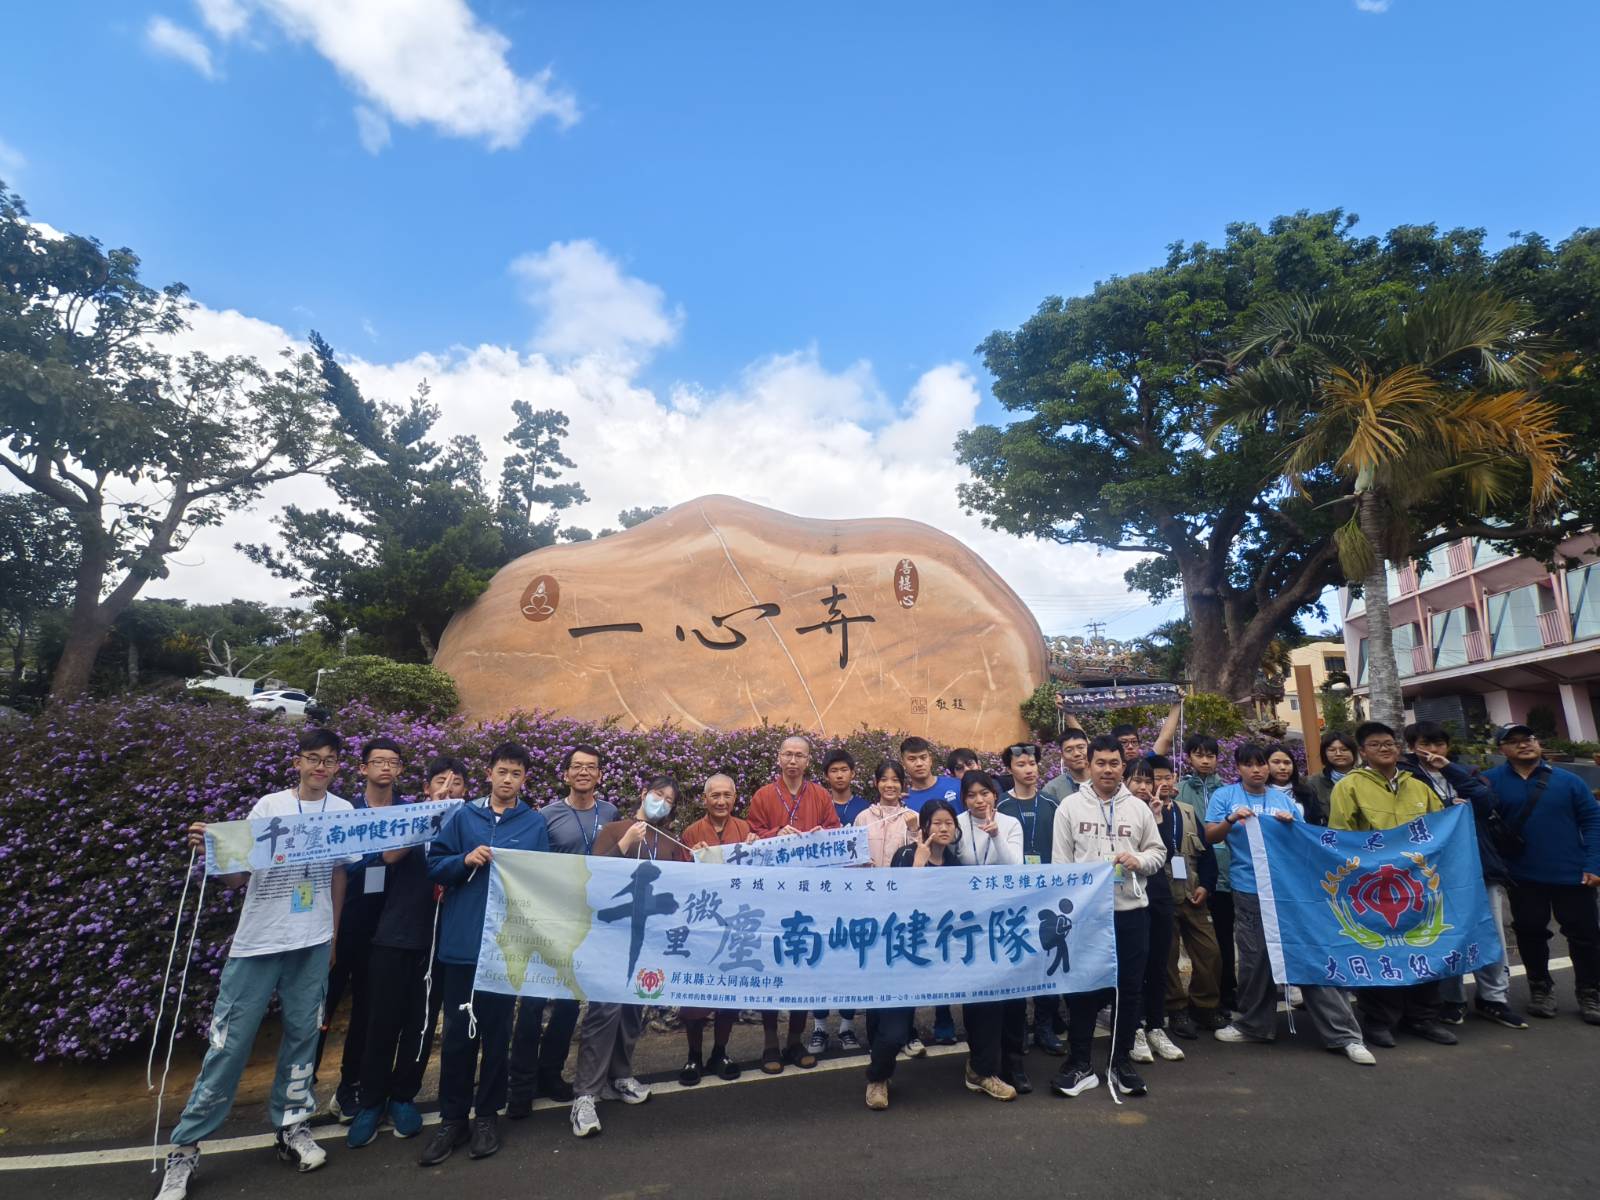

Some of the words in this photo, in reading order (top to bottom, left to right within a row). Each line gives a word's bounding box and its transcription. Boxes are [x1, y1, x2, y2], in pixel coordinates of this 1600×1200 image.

[968, 873, 1094, 891] 全球思維在地行動
[670, 971, 784, 989] 屏東縣立大同高級中學
